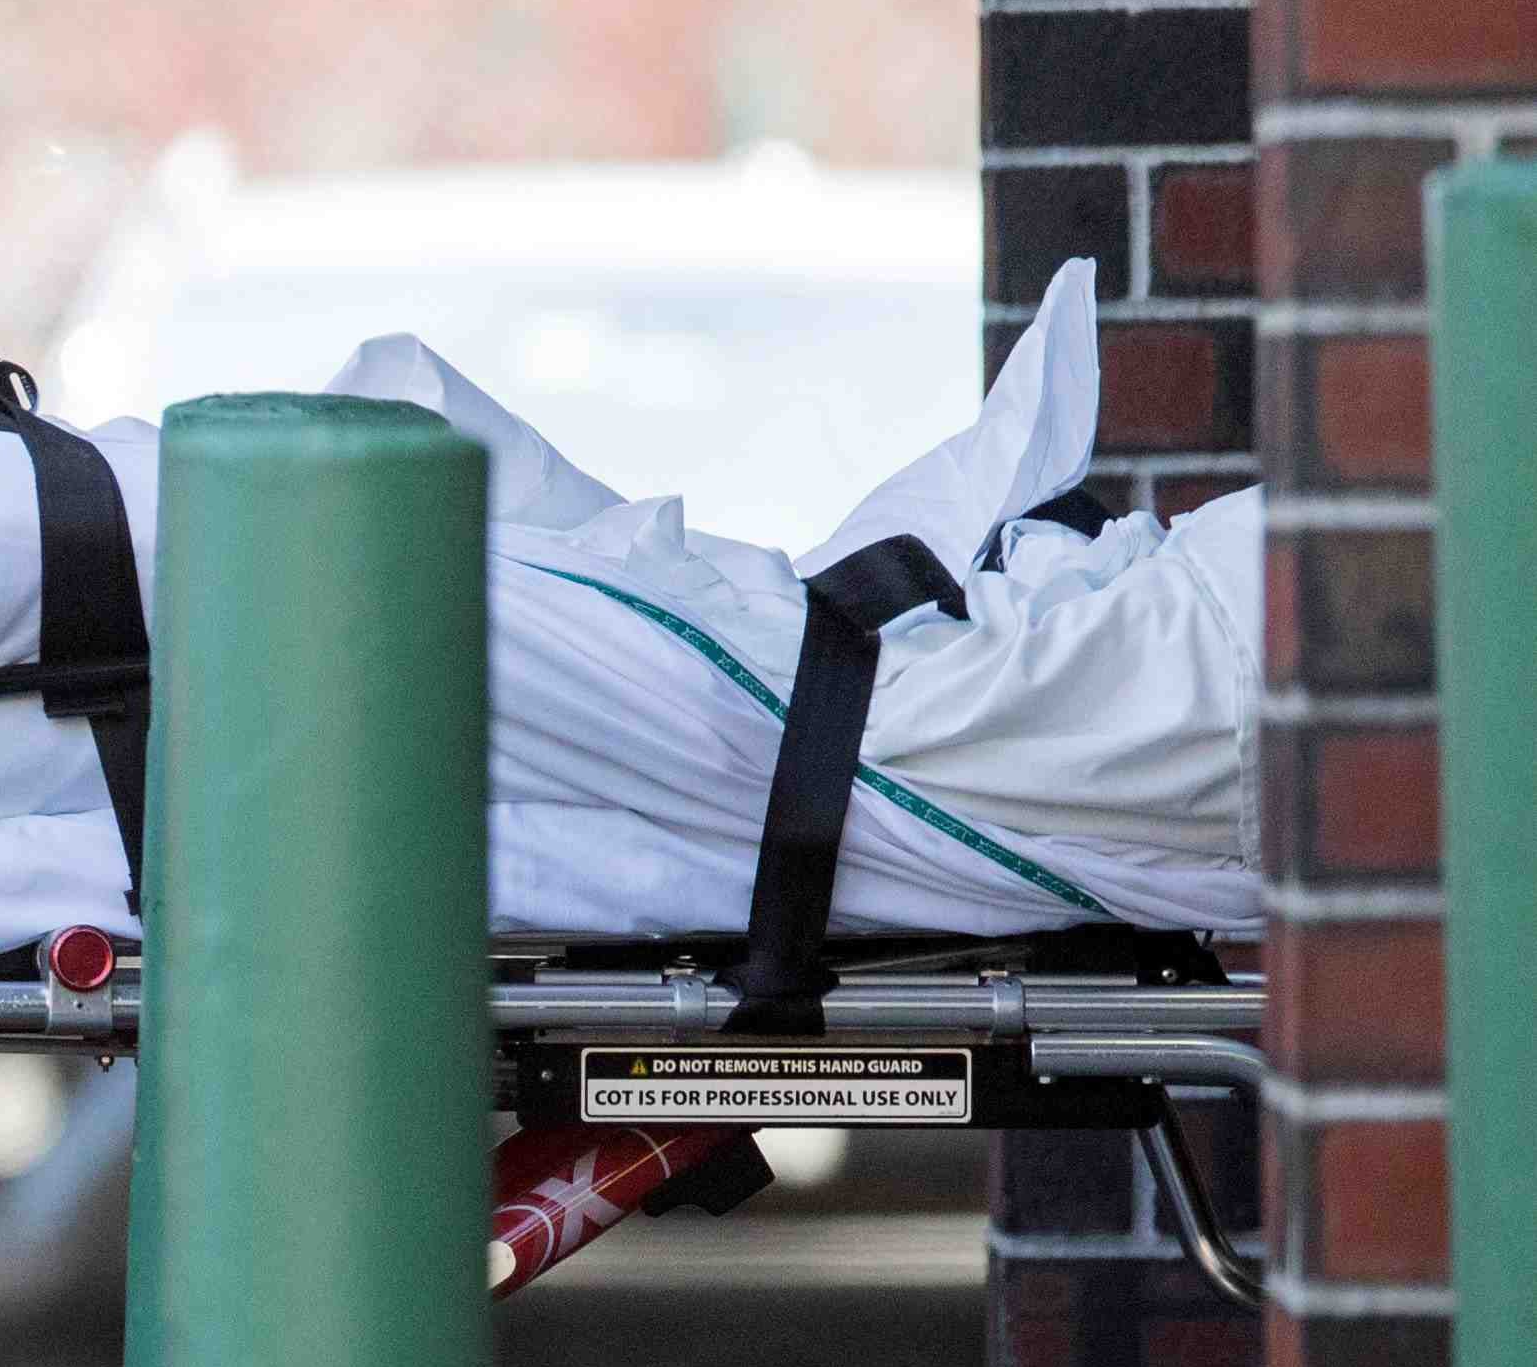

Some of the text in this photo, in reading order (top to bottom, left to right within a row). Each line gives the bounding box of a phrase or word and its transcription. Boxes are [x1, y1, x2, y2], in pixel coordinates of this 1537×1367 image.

[652, 1059, 923, 1073] DO NOT REMOVE THIS HAND GUARD
[594, 1090, 957, 1106] COT IS FOR PROFESSIONAL USE ONLY
